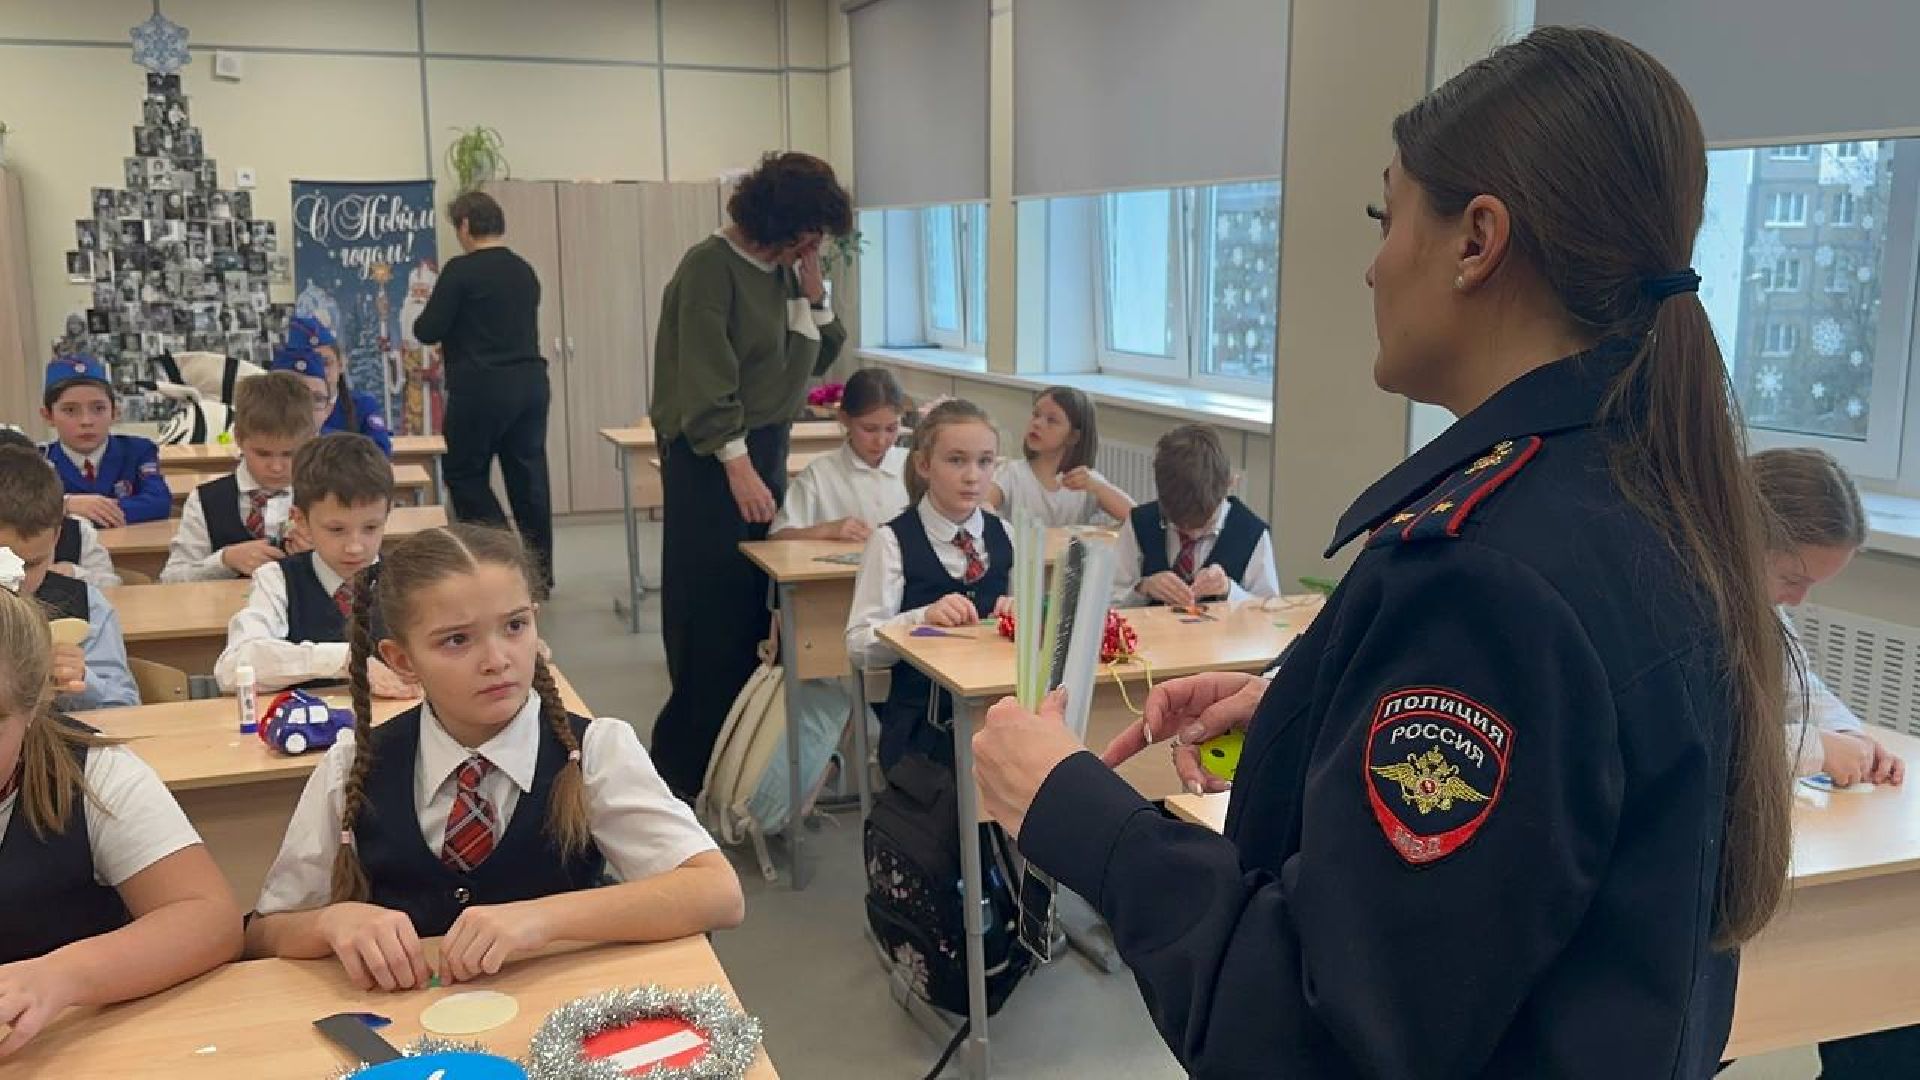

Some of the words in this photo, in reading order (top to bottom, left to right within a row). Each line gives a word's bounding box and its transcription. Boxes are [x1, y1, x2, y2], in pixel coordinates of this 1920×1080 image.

[294, 193, 329, 247] С
[331, 193, 434, 241] Новым
[340, 231, 415, 281] годом!
[1383, 695, 1505, 748] ПОЛИЦИЯ
[1389, 723, 1484, 769] РОССИЯ
